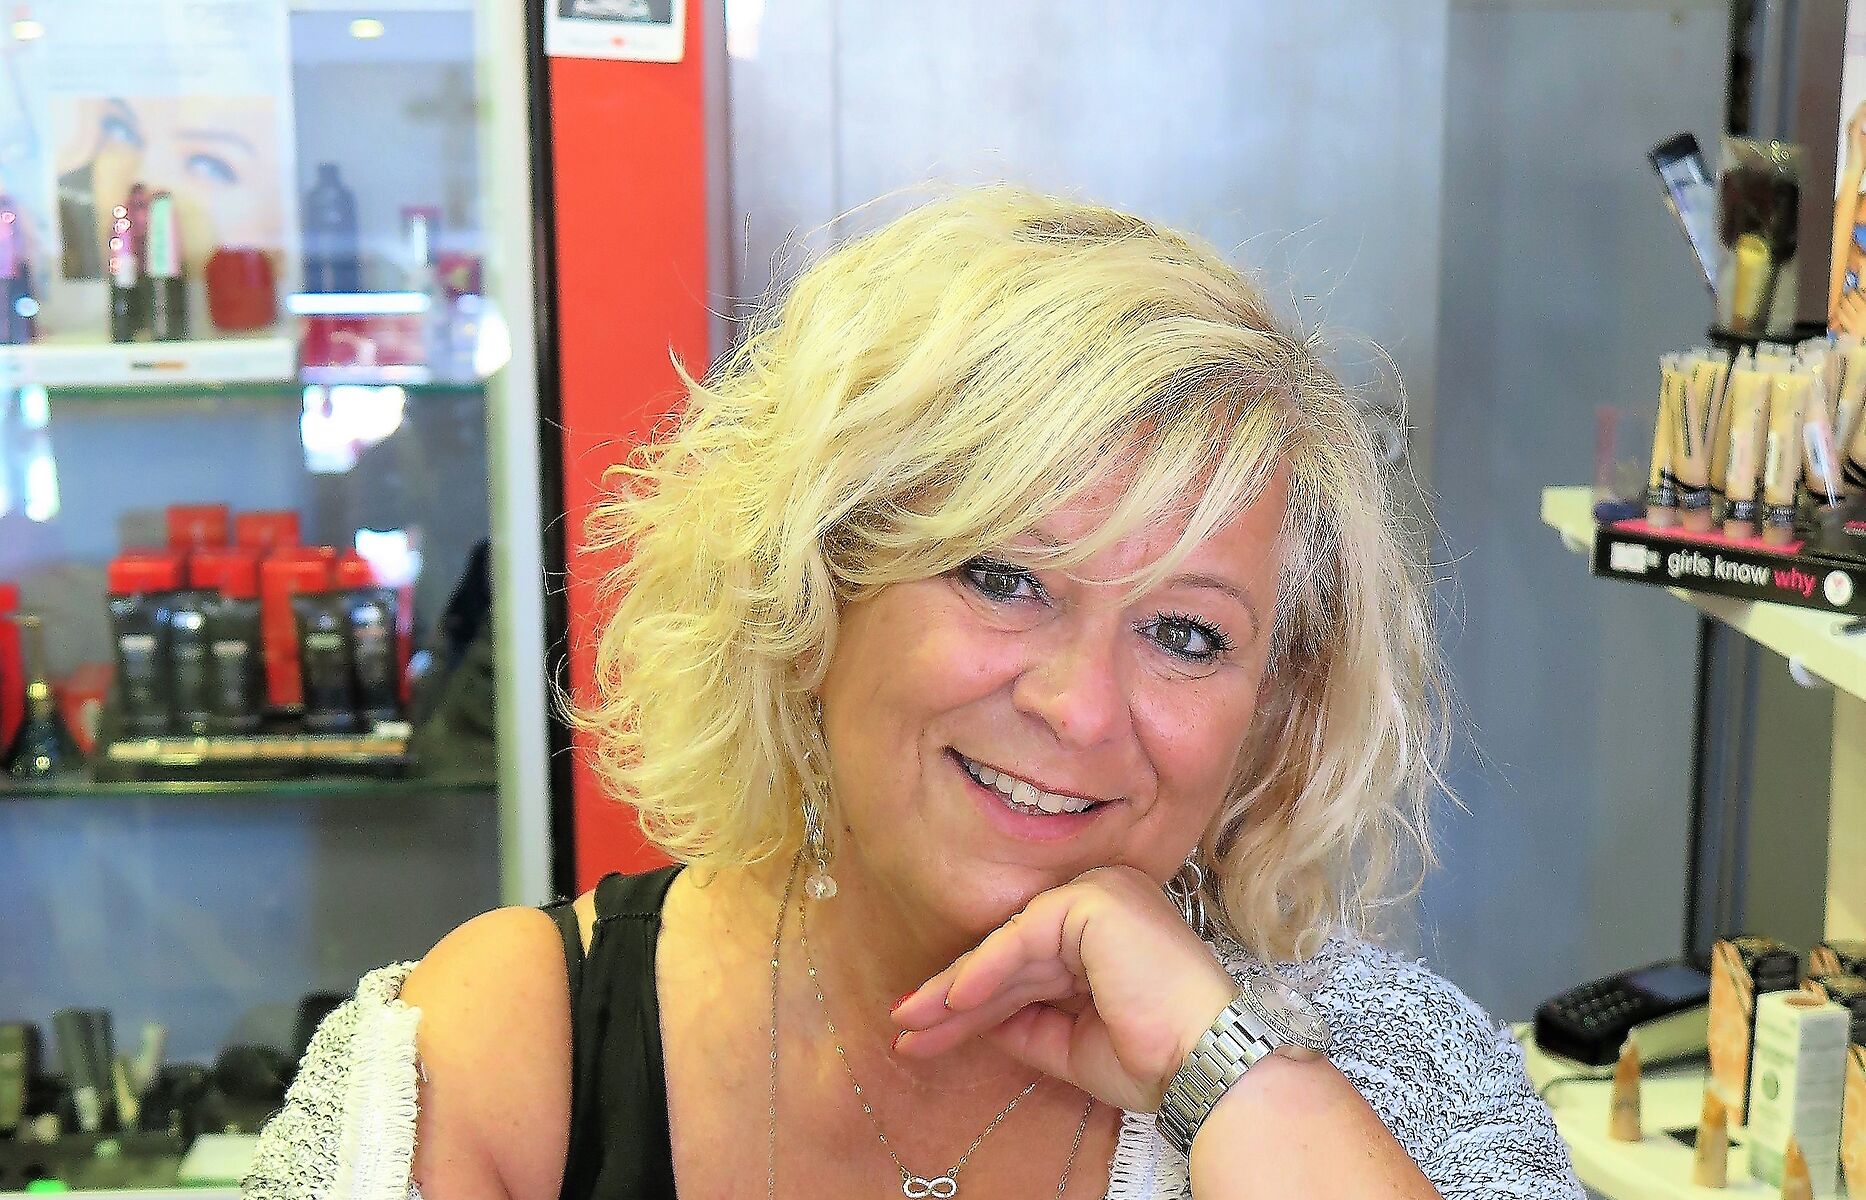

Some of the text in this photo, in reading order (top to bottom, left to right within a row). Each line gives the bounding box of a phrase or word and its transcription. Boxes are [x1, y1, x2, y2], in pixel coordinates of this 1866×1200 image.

[1667, 549, 1817, 599] girls know why
